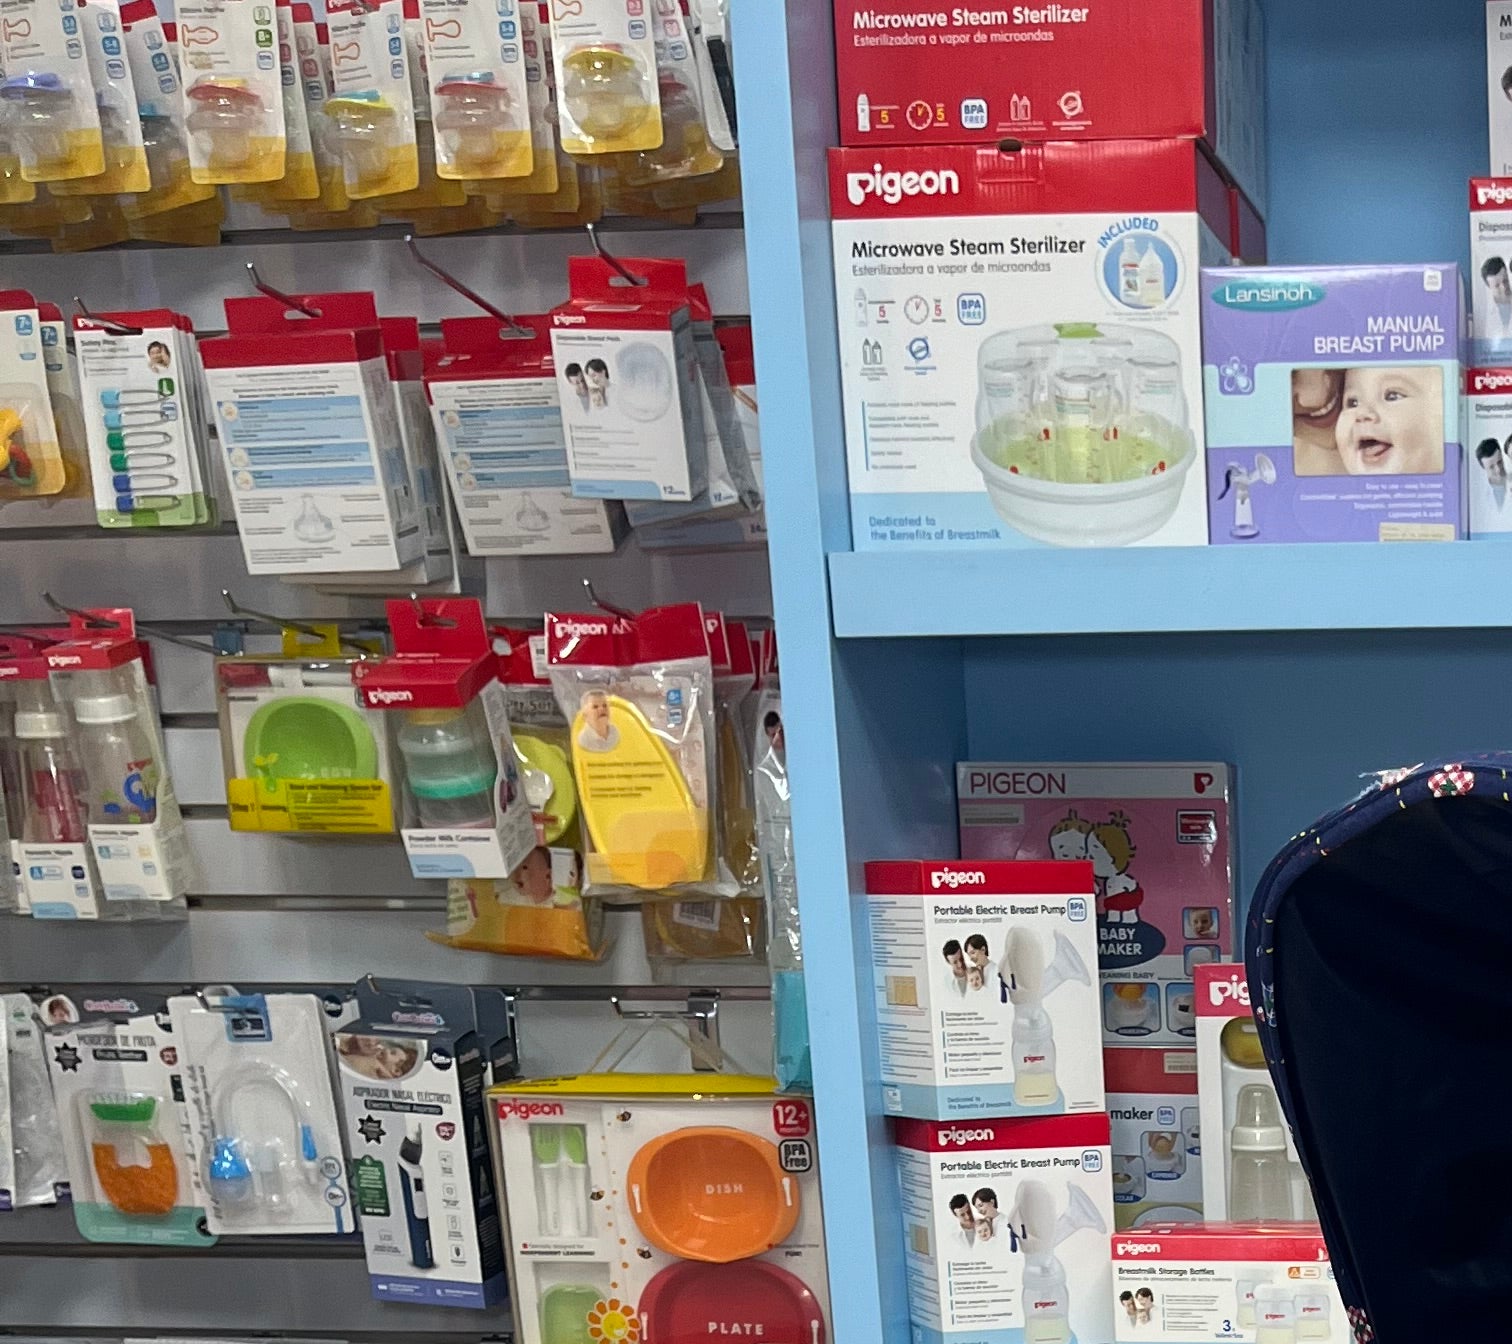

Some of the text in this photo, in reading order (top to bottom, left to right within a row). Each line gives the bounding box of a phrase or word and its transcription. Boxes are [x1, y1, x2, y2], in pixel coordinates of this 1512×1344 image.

[853, 4, 1089, 29] Microwave Steam Sterilizer
[853, 29, 1054, 47] Esterilizadora a vapor de microondas
[963, 104, 985, 115] BPA
[847, 163, 960, 206] pigeon
[1097, 217, 1160, 250] INCLUDED
[852, 236, 1086, 258] Microwave Steam Sterilizer
[852, 261, 1052, 277] Esterilizadora a vapor de microondas
[1224, 285, 1313, 304] Lansinoh
[879, 305, 887, 318] 5
[935, 304, 943, 317] 5
[961, 299, 982, 311] BPA
[1367, 316, 1445, 335] MANUAL
[1314, 335, 1445, 355] BREAST PUMP
[869, 515, 937, 528] Dedicated to
[870, 529, 887, 541] the
[889, 529, 932, 541] Benefits
[934, 528, 945, 541] of
[554, 617, 608, 639] pigeon
[367, 688, 413, 704] pigeon
[969, 772, 1067, 795] PIGEON
[931, 867, 986, 889] pigeon
[934, 904, 1066, 917] Portable Electric Breast Pump
[1100, 928, 1136, 941] BABY
[498, 1099, 564, 1120] pigeon
[775, 1103, 809, 1126] 12+
[1110, 1106, 1154, 1121] maker
[937, 1126, 995, 1147] pigeon
[782, 1144, 808, 1157] BPA
[782, 1156, 809, 1169] Free
[940, 1157, 1081, 1172] Portable Electric Breast Pump
[705, 1183, 744, 1195] DISH
[1117, 1240, 1161, 1256] pigeon
[1118, 1267, 1215, 1277] Breastmilk Storage Bottles
[707, 1321, 764, 1337] PLATE
[1222, 1319, 1232, 1333] 3
